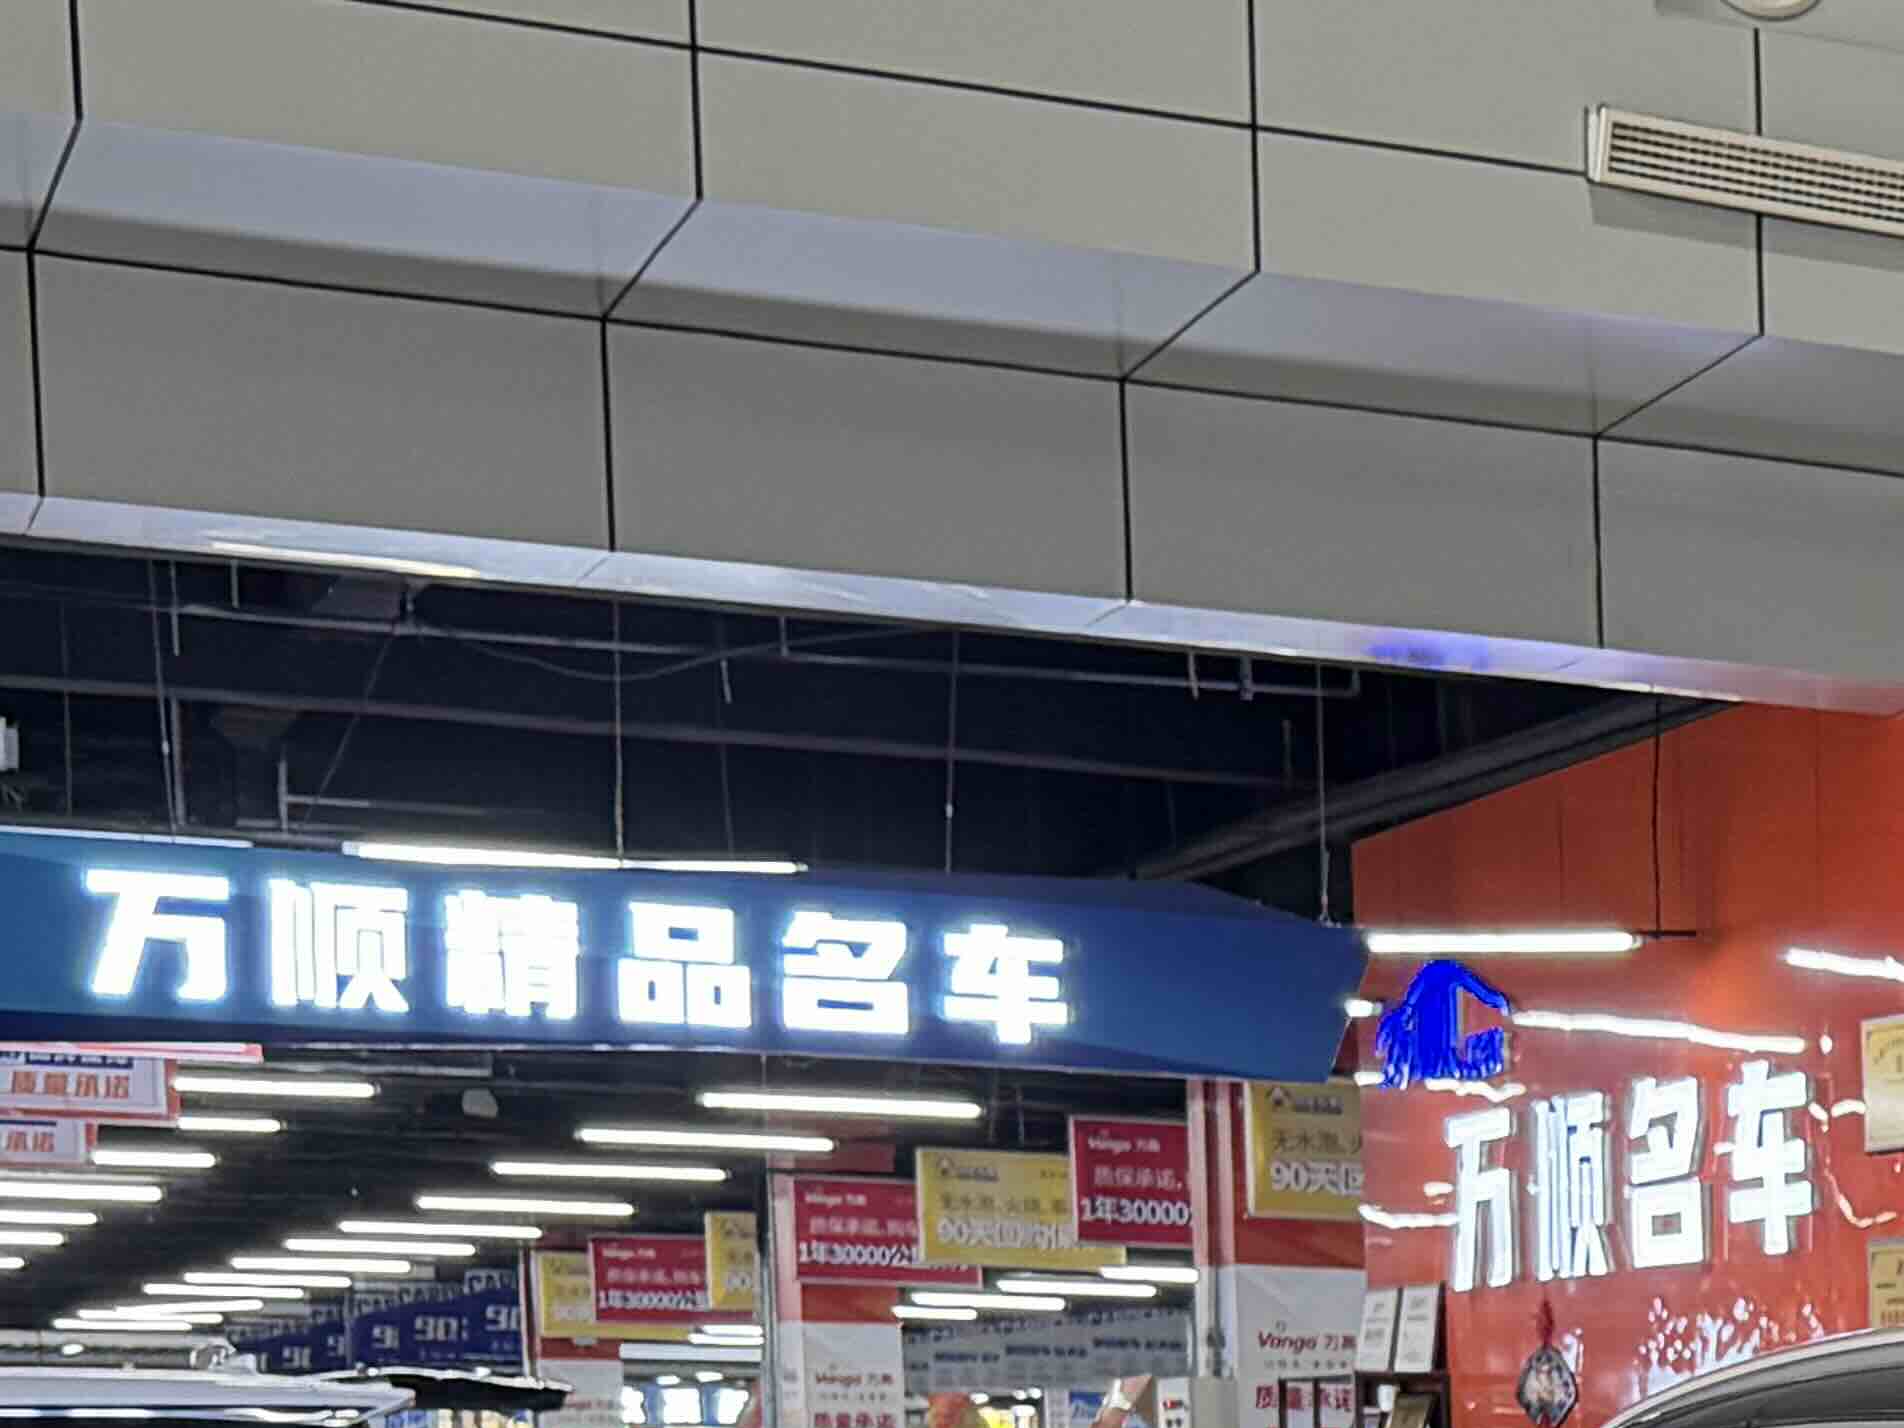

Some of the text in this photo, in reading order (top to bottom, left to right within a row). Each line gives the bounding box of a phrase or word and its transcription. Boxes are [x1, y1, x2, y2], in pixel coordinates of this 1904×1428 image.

[84, 866, 1071, 1046] 万顺精品名车
[1444, 1058, 1816, 1294] 万顺名车
